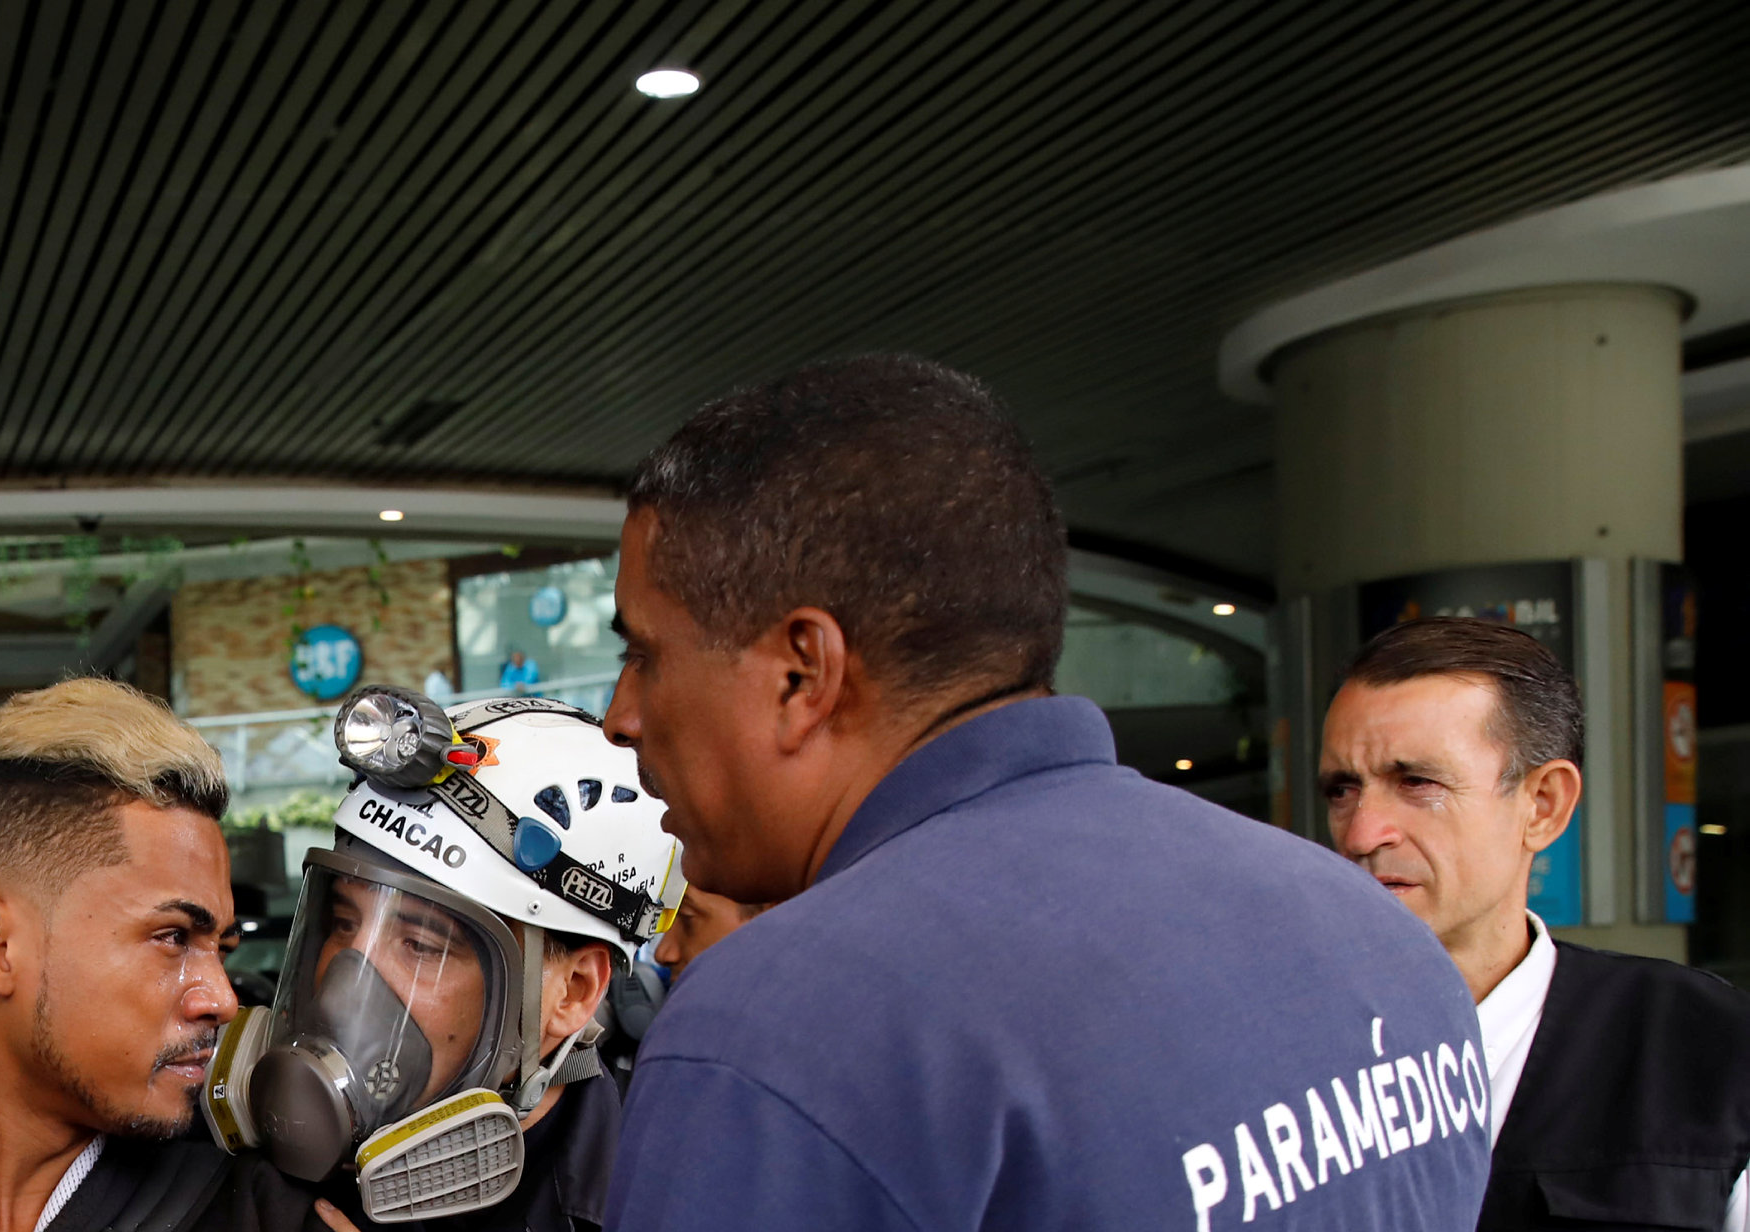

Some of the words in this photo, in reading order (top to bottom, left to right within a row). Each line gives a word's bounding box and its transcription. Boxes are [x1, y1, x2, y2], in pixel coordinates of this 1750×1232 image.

[440, 772, 486, 821] ETZL
[358, 799, 467, 869] CHACAO
[562, 868, 613, 910] PETZL
